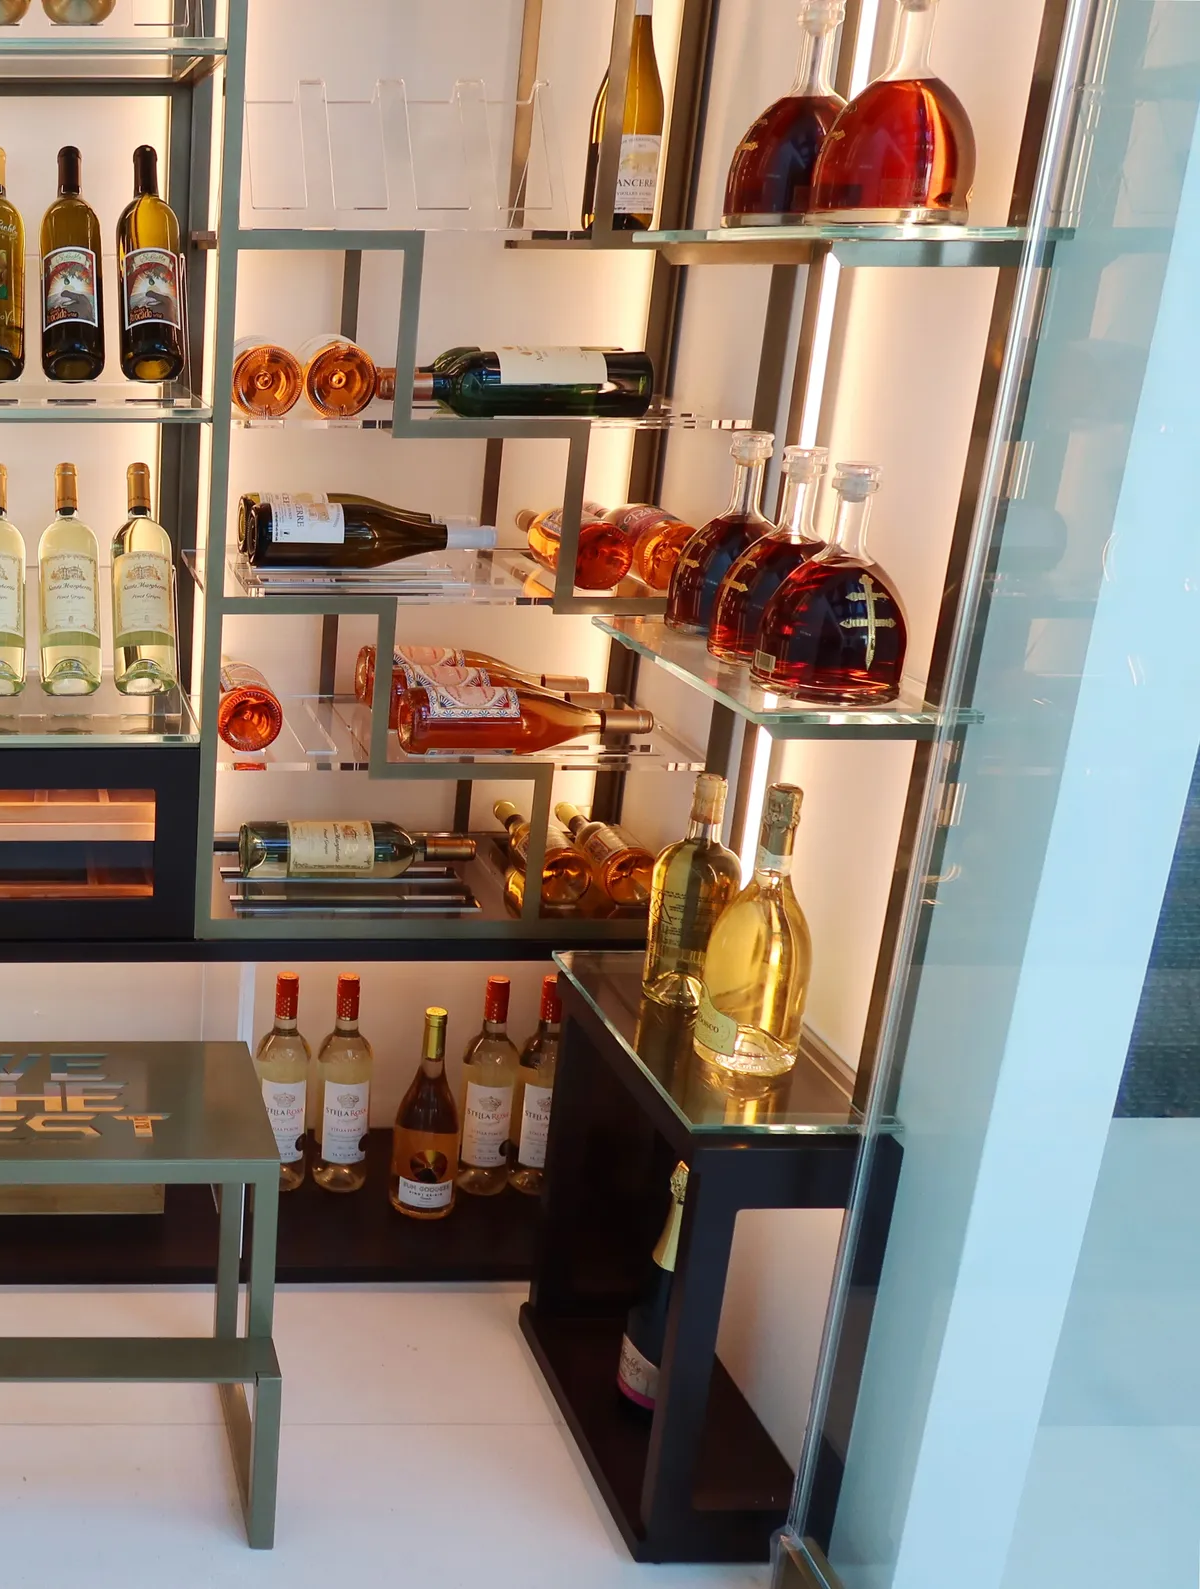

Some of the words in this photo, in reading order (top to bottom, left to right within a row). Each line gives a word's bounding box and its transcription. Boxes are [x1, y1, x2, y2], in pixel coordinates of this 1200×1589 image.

[616, 179, 655, 187] ANCERR
[294, 504, 305, 528] ERRE
[325, 1107, 350, 1117] STELLA
[467, 1109, 491, 1120] STELLA
[525, 1110, 549, 1121] STELLA
